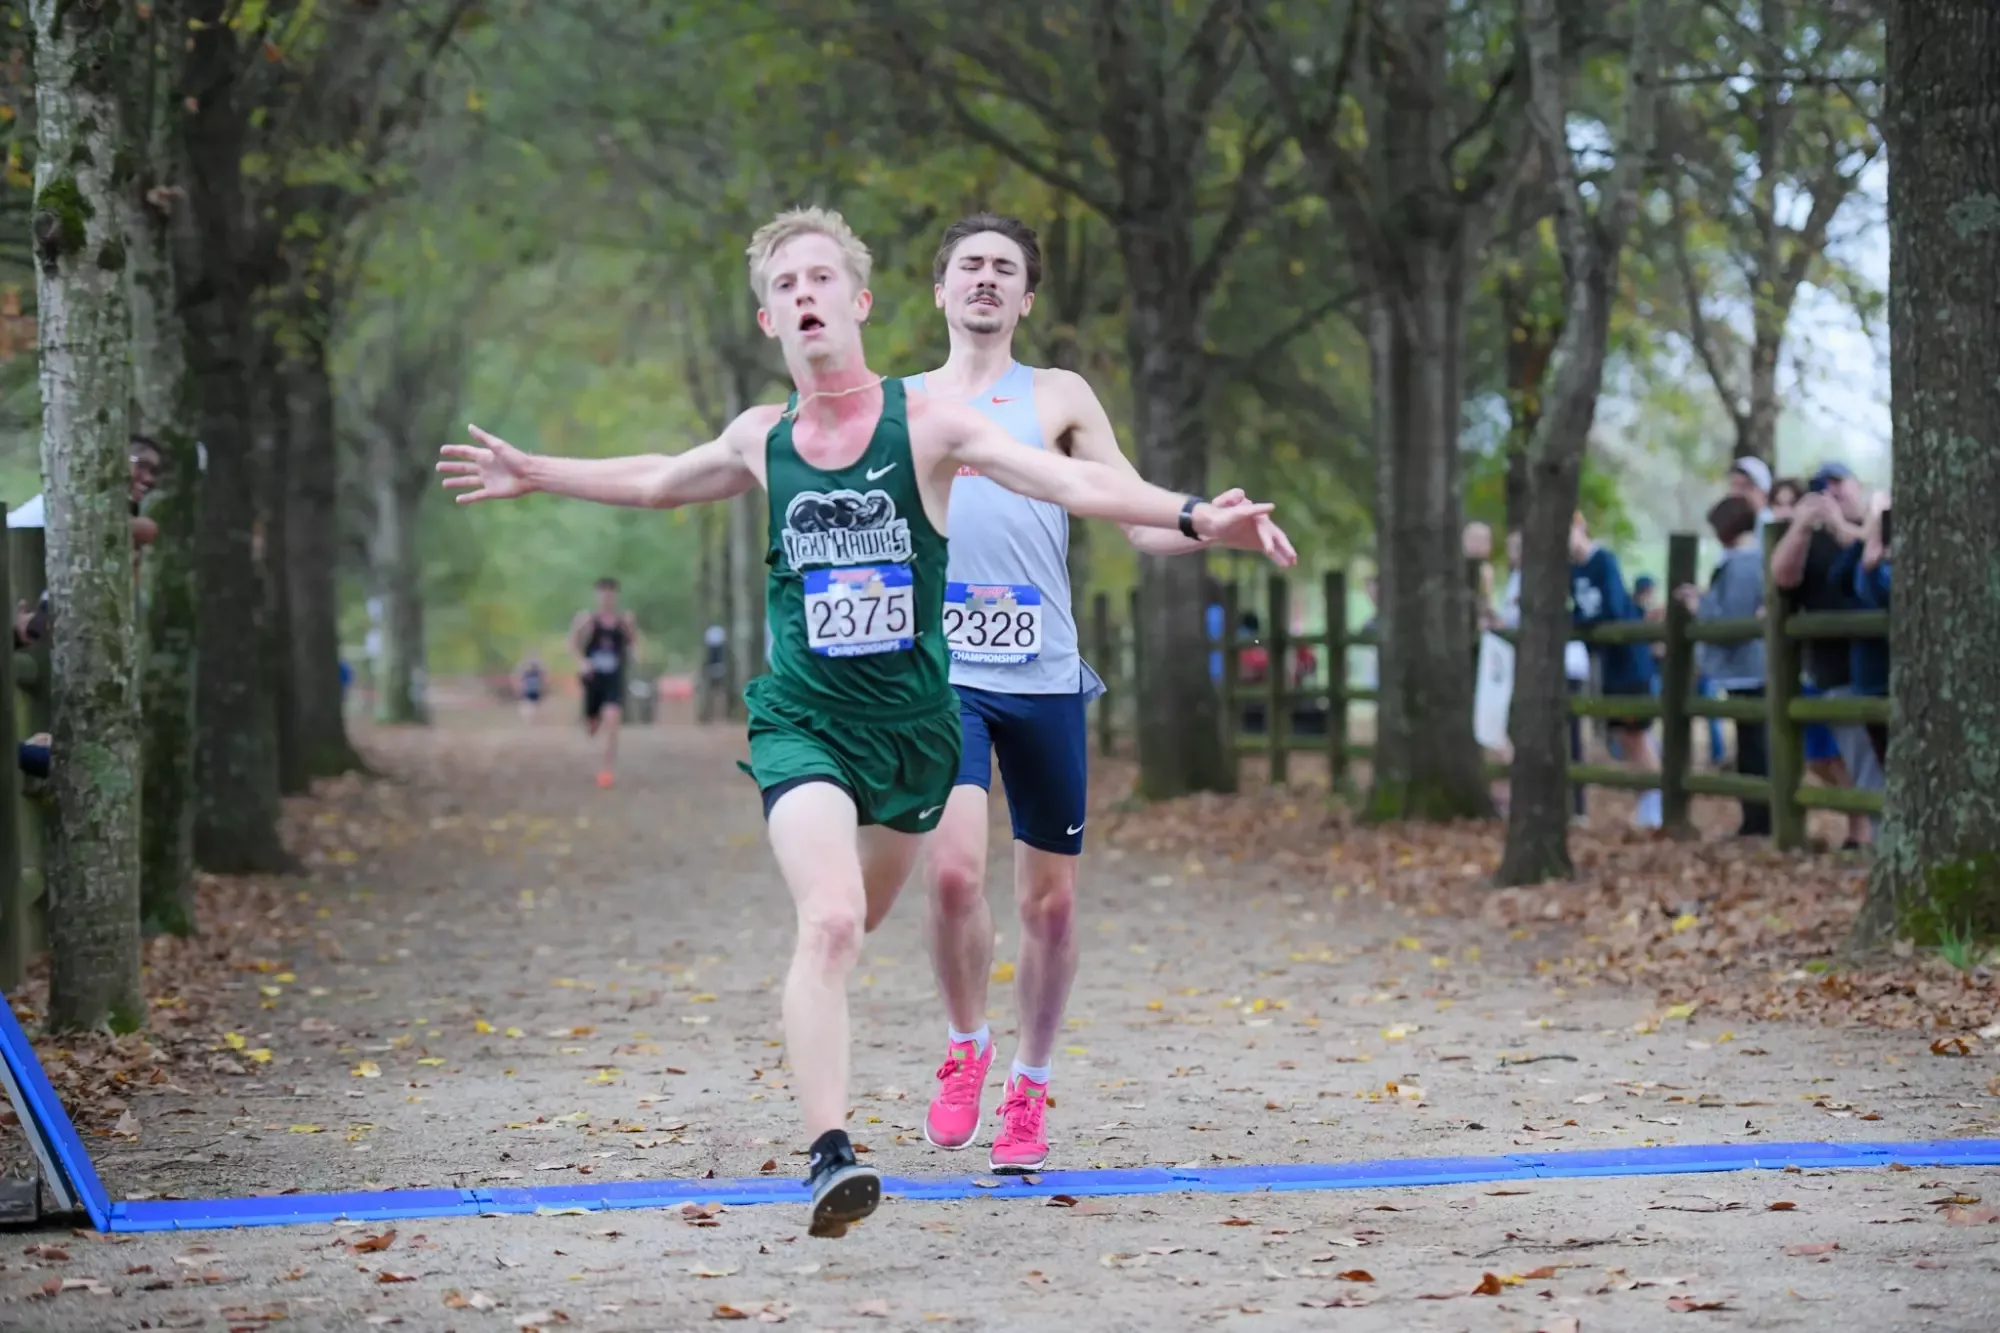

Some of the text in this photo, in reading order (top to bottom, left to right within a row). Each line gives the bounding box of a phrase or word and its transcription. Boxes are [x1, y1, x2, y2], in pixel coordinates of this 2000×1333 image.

[812, 594, 908, 639] 2375
[944, 608, 1035, 648] 2328
[951, 651, 1028, 664] CHAMPIONSHIPS
